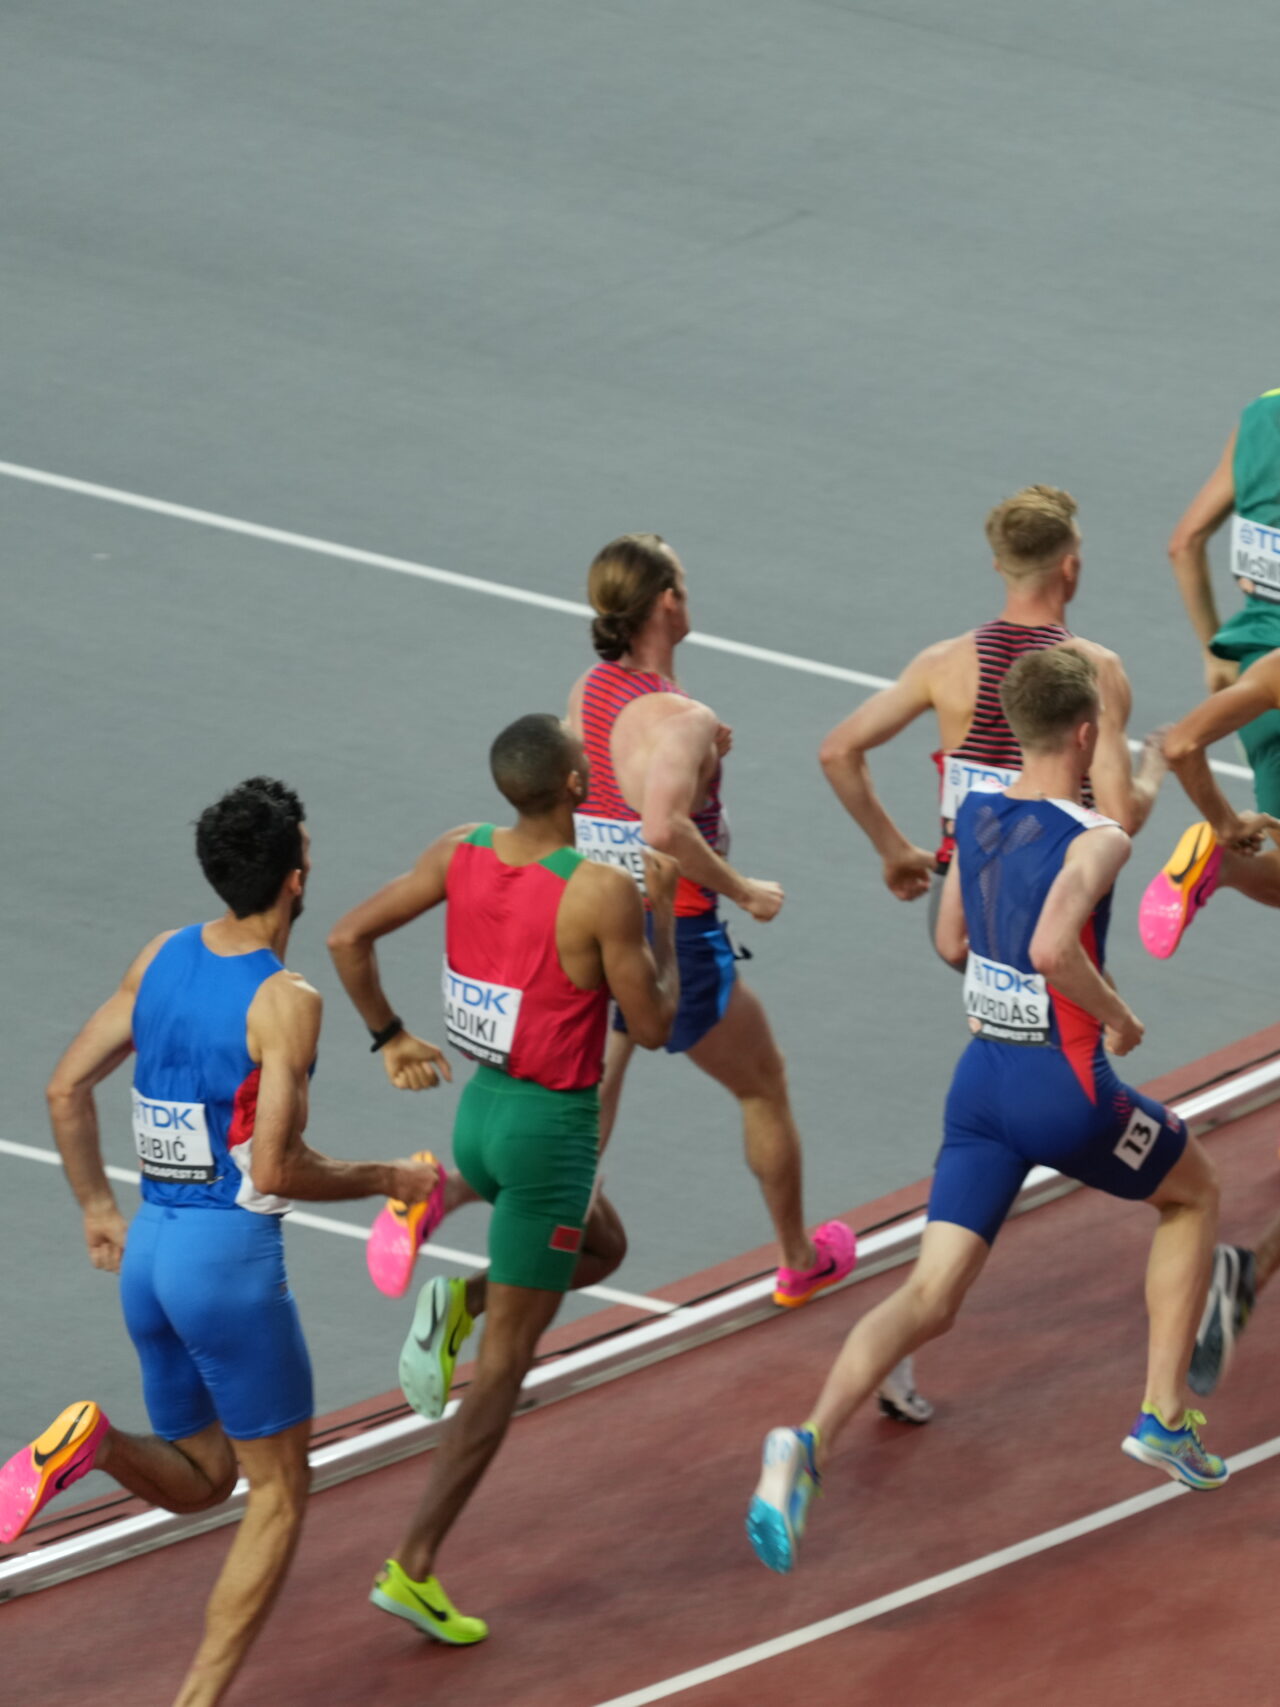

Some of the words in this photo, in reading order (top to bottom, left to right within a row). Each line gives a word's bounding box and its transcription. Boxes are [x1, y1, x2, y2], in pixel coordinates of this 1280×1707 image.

[591, 821, 647, 846] TDK
[447, 972, 510, 1016] TDK
[981, 962, 1039, 995] TDK
[139, 1101, 196, 1131] TDK
[1121, 1122, 1152, 1155] 13
